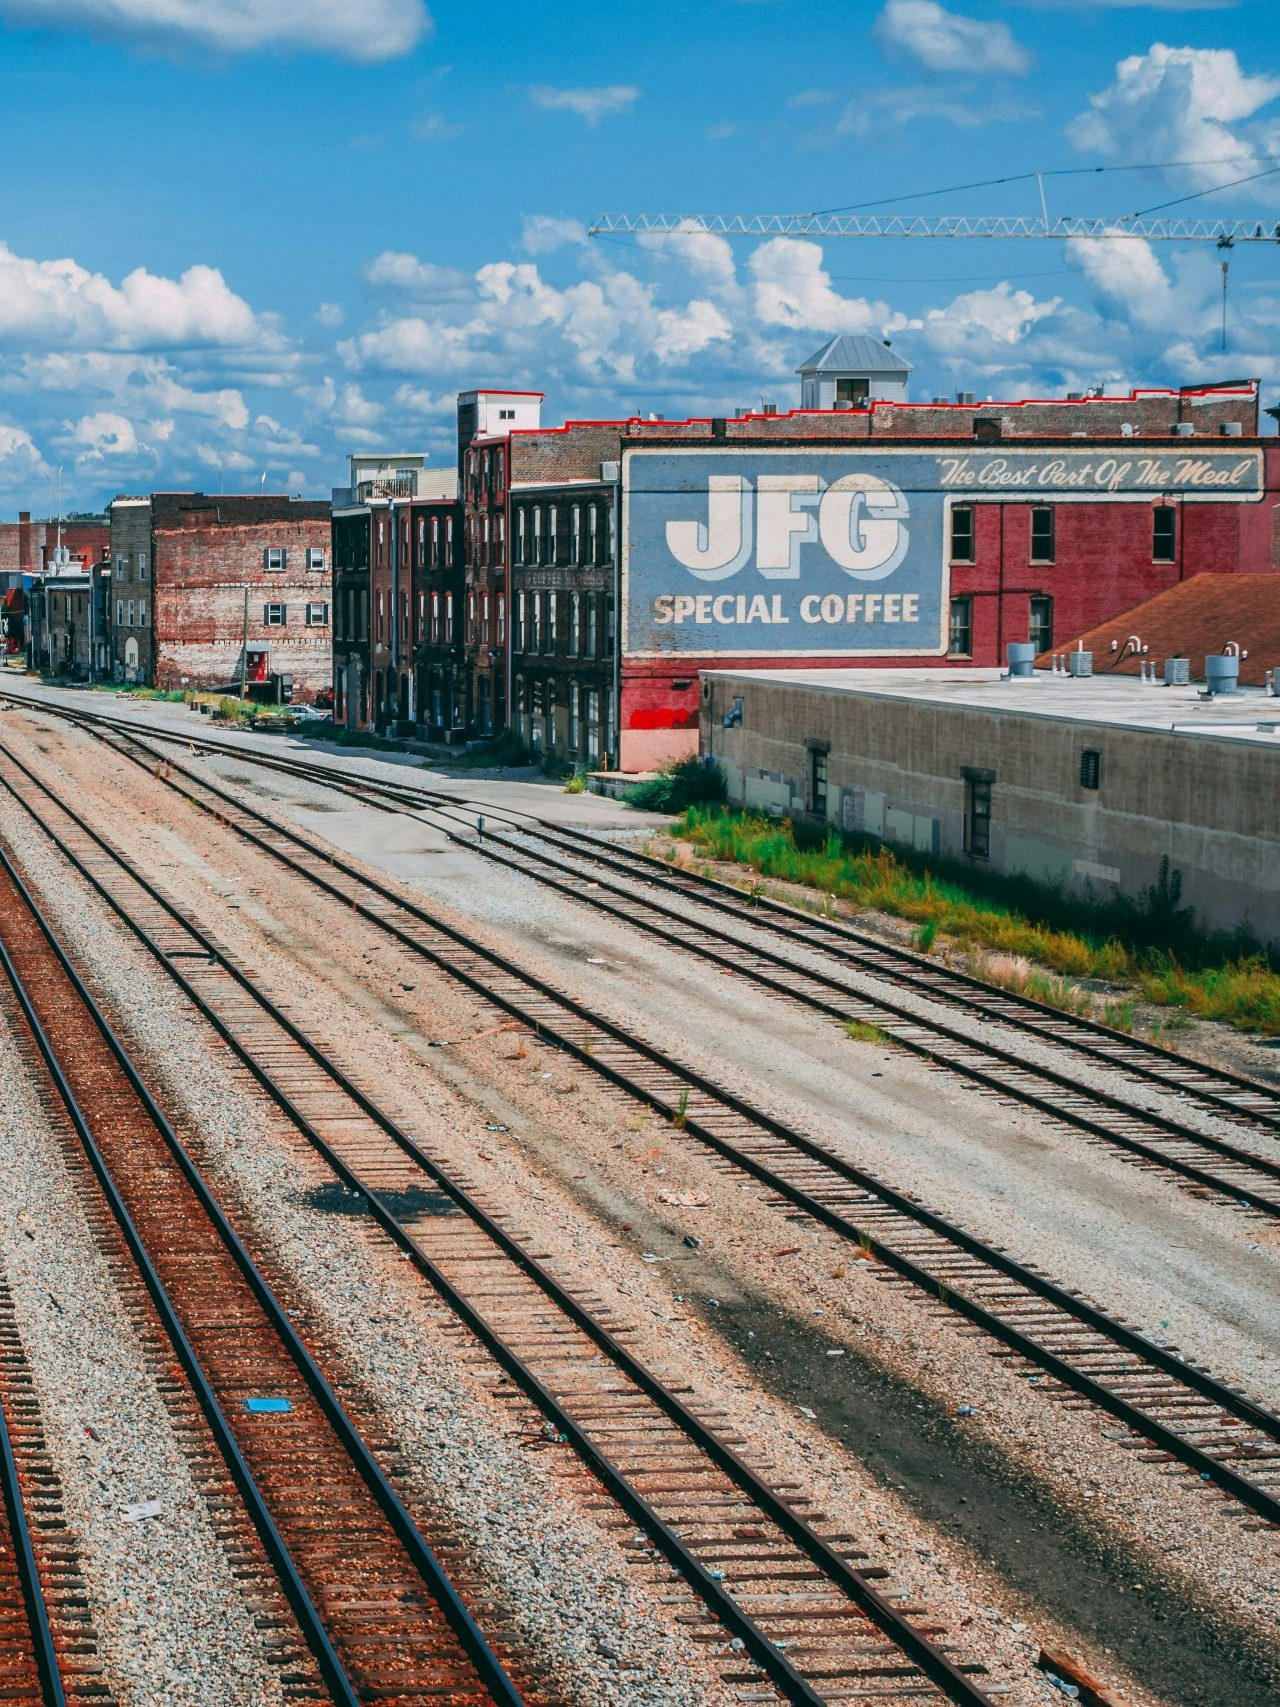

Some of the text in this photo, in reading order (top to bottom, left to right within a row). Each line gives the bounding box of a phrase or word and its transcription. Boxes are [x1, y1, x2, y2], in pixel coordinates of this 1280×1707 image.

[978, 458, 1038, 485] Best
[1038, 461, 1093, 485] Part
[1094, 460, 1132, 492] Of
[1136, 459, 1171, 485] The
[666, 473, 910, 581] JFG
[654, 593, 919, 624] SPECIAL COFFEE
